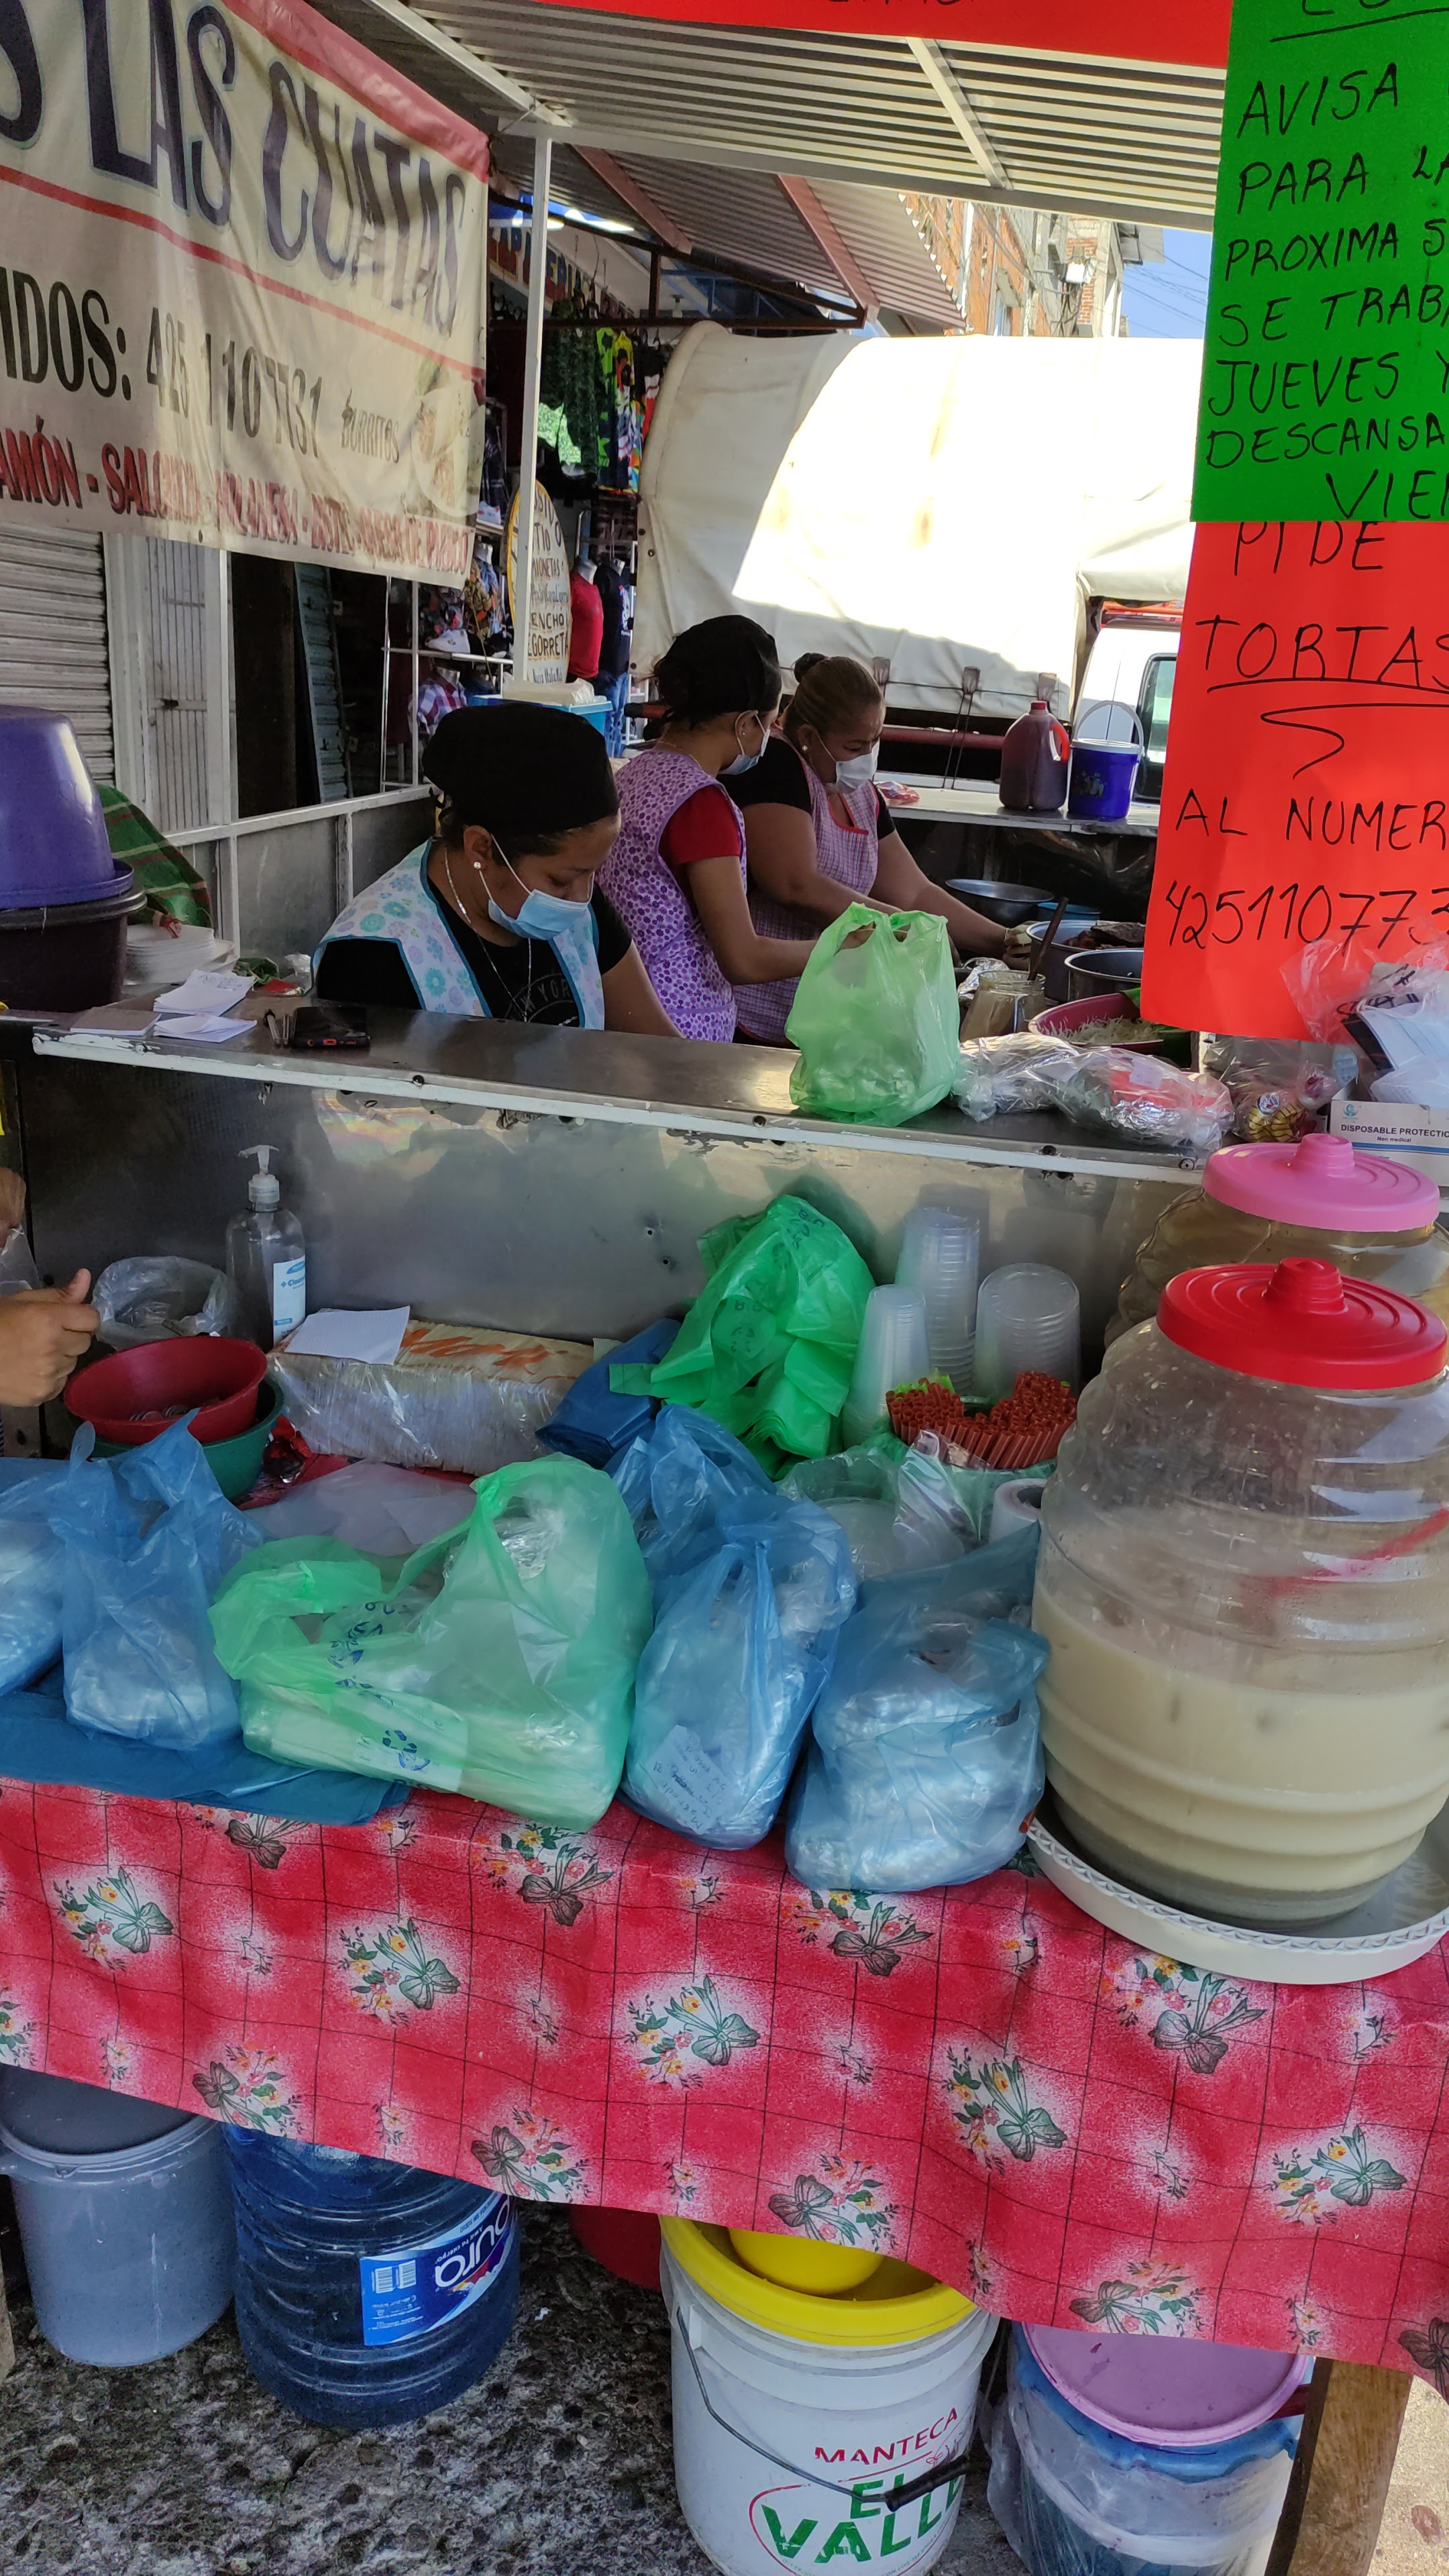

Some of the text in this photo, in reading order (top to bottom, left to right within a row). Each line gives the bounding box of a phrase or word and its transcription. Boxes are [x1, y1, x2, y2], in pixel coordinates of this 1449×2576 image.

[1238, 62, 1399, 138] AVISA
[82, 0, 233, 227] LAS
[263, 61, 466, 337] CUATAS
[1238, 152, 1368, 214] PARA
[1225, 222, 1399, 280] PROXIMA
[1221, 283, 1449, 347] SE TRAB
[1208, 352, 1399, 416] JUEVES
[1206, 412, 1446, 469] DESCANSA
[1234, 521, 1385, 576] PIDE
[1176, 789, 1446, 852] AL NUMER
[1341, 1124, 1397, 1134] DISPOSABLE
[814, 2407, 958, 2465] MANTECA
